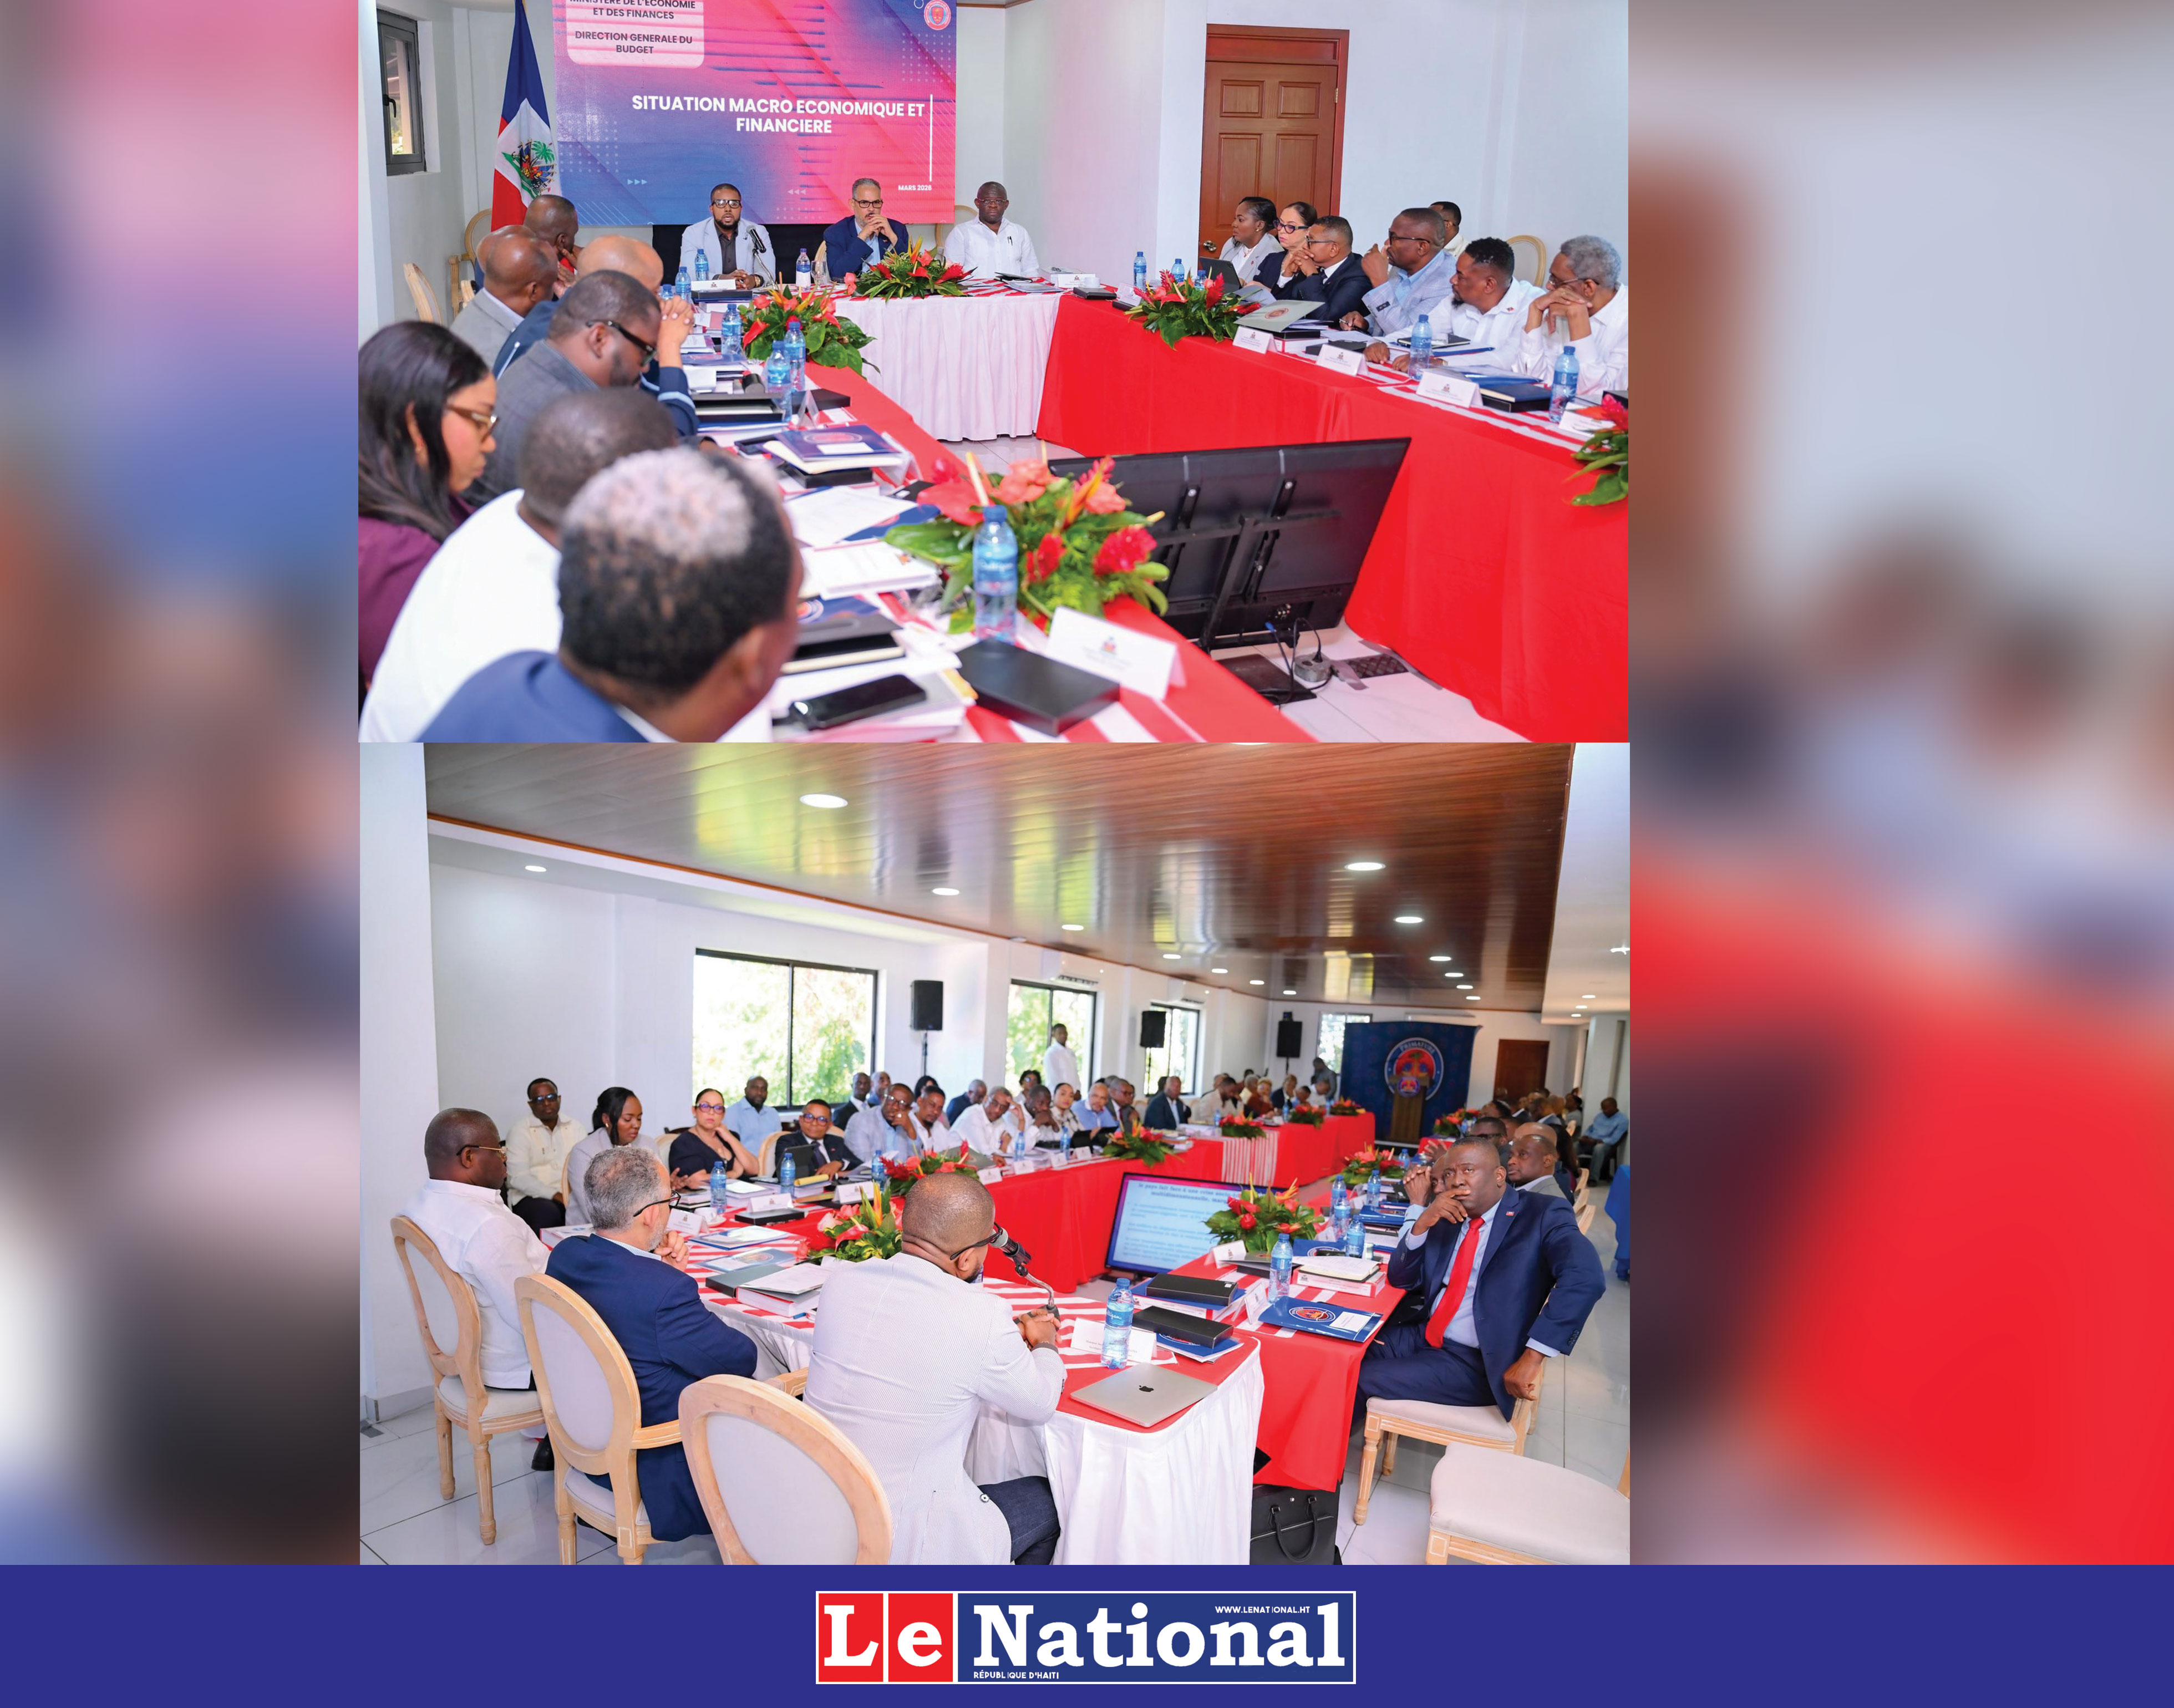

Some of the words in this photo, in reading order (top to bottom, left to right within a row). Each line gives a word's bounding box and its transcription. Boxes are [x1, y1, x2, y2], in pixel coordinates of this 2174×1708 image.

[606, 8, 624, 17] DES
[627, 9, 674, 19] FINANCES
[575, 31, 628, 41] DIRECTION
[630, 34, 677, 43] GENERALE
[616, 45, 654, 54] BUDGET
[632, 95, 725, 111] SITUATION
[729, 98, 793, 114] MACRO
[796, 100, 904, 118] ECONOMIQUE
[908, 103, 925, 117] ET
[736, 118, 832, 133] FINANCIERE
